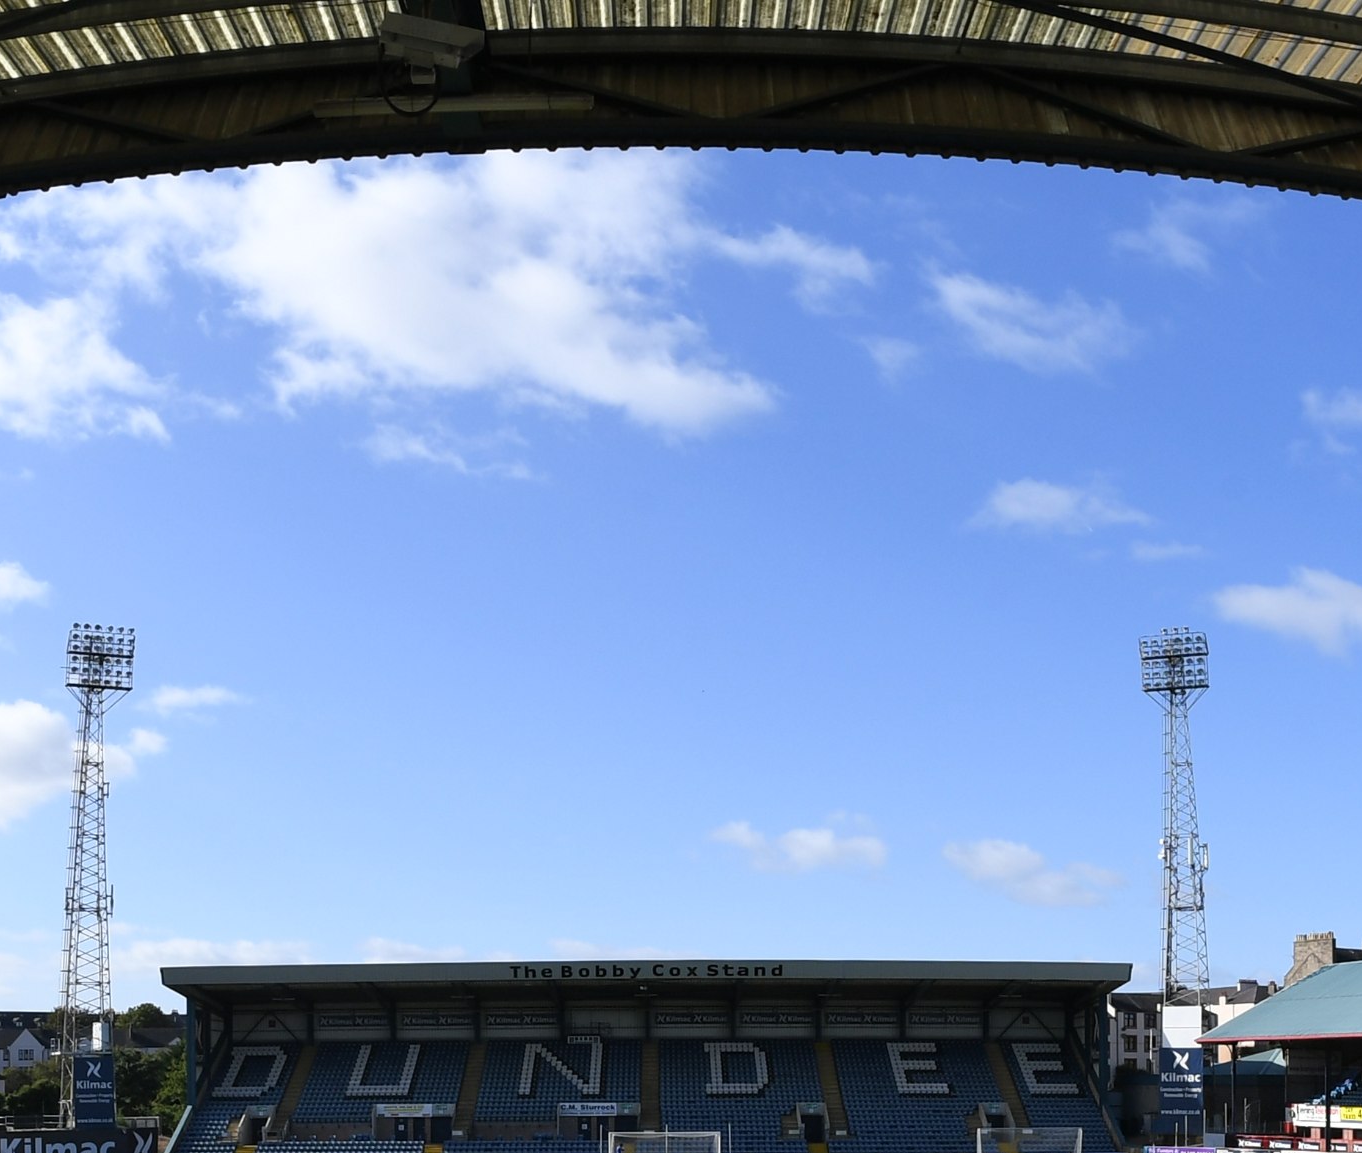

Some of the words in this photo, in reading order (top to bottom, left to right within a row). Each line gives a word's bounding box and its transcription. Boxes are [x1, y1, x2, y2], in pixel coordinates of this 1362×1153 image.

[510, 966, 554, 978] The
[561, 965, 641, 981] Bobby
[652, 964, 699, 978] Cox
[707, 963, 784, 978] Stand
[1161, 1073, 1201, 1082] Kilmac
[77, 1080, 112, 1089] Kilmac
